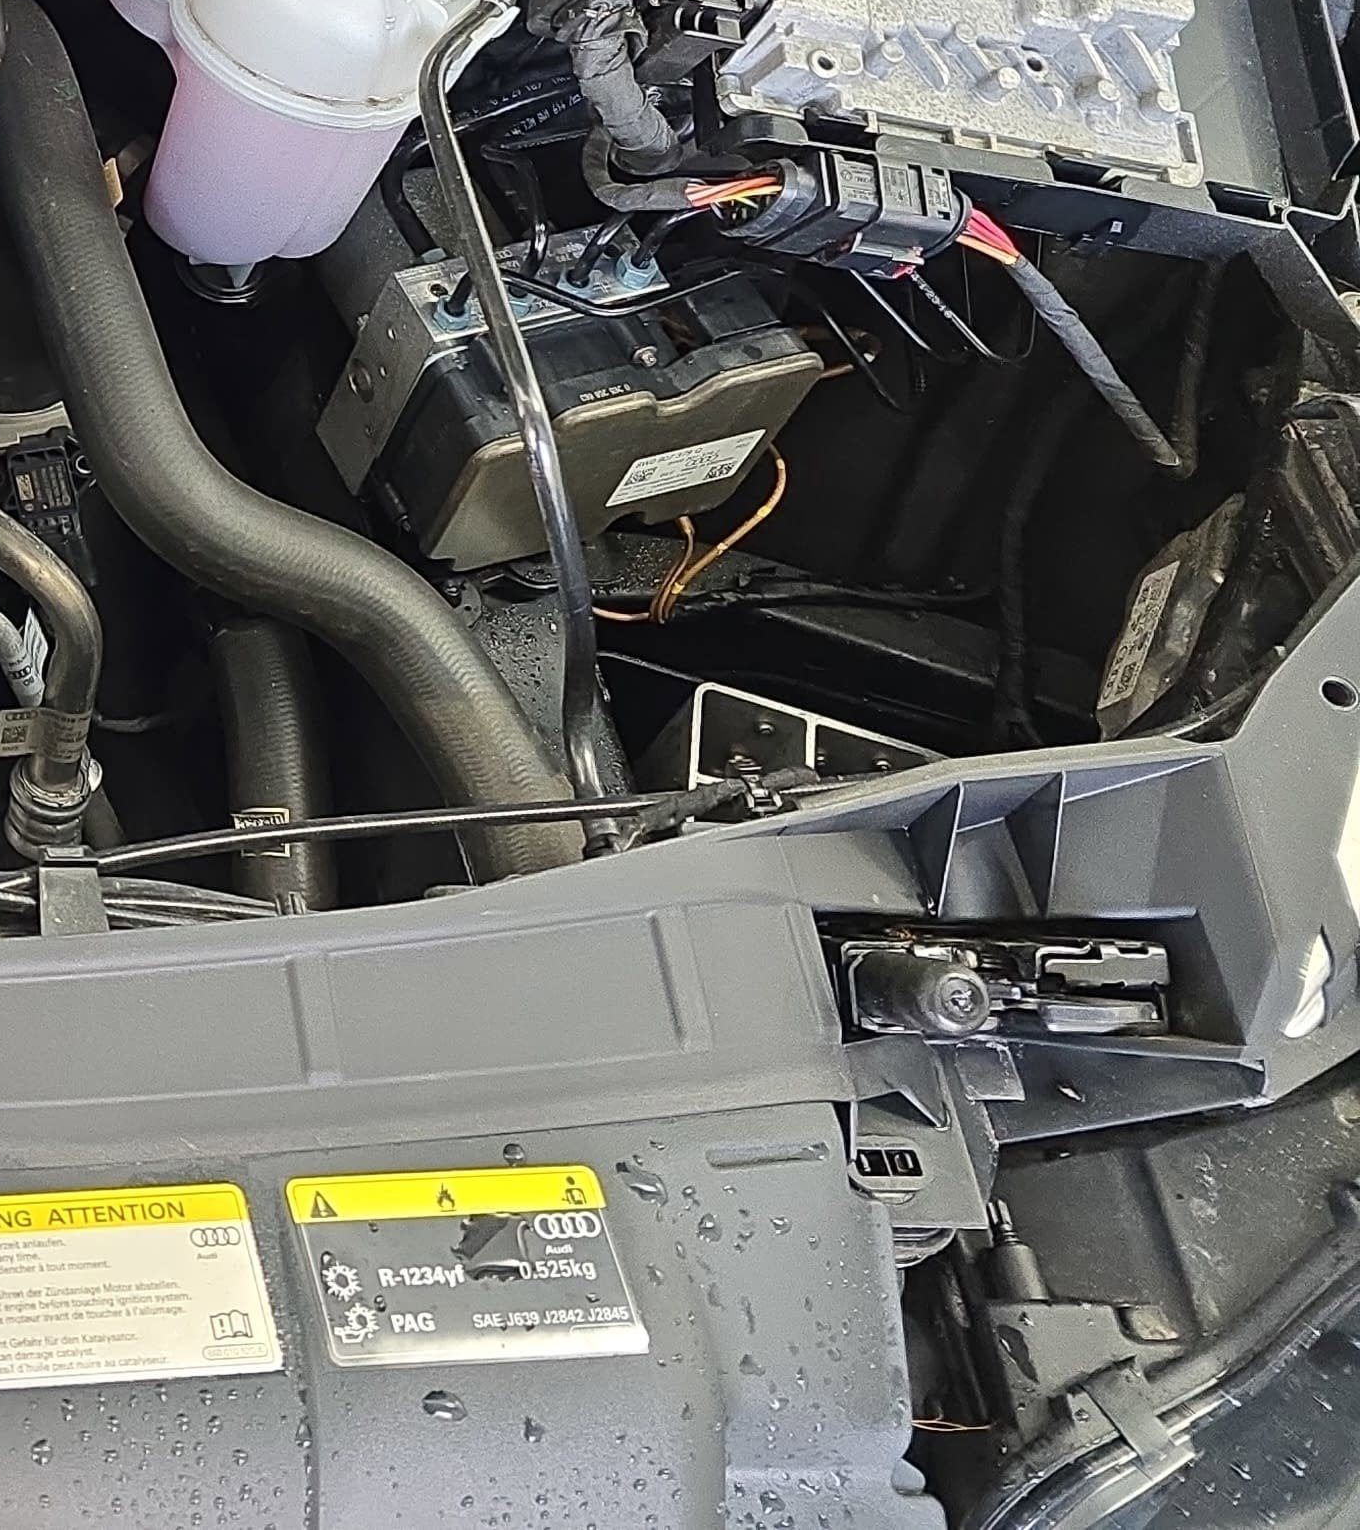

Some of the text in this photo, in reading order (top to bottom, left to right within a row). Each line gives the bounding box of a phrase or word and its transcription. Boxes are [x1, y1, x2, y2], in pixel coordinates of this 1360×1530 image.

[47, 1200, 186, 1226] ATTENTION
[545, 1244, 573, 1256] Audi
[378, 1259, 597, 1288] R-1234yf 0.525kg
[391, 1312, 436, 1333] PAG
[473, 1306, 630, 1329] SAE J639 J2842 J2845
